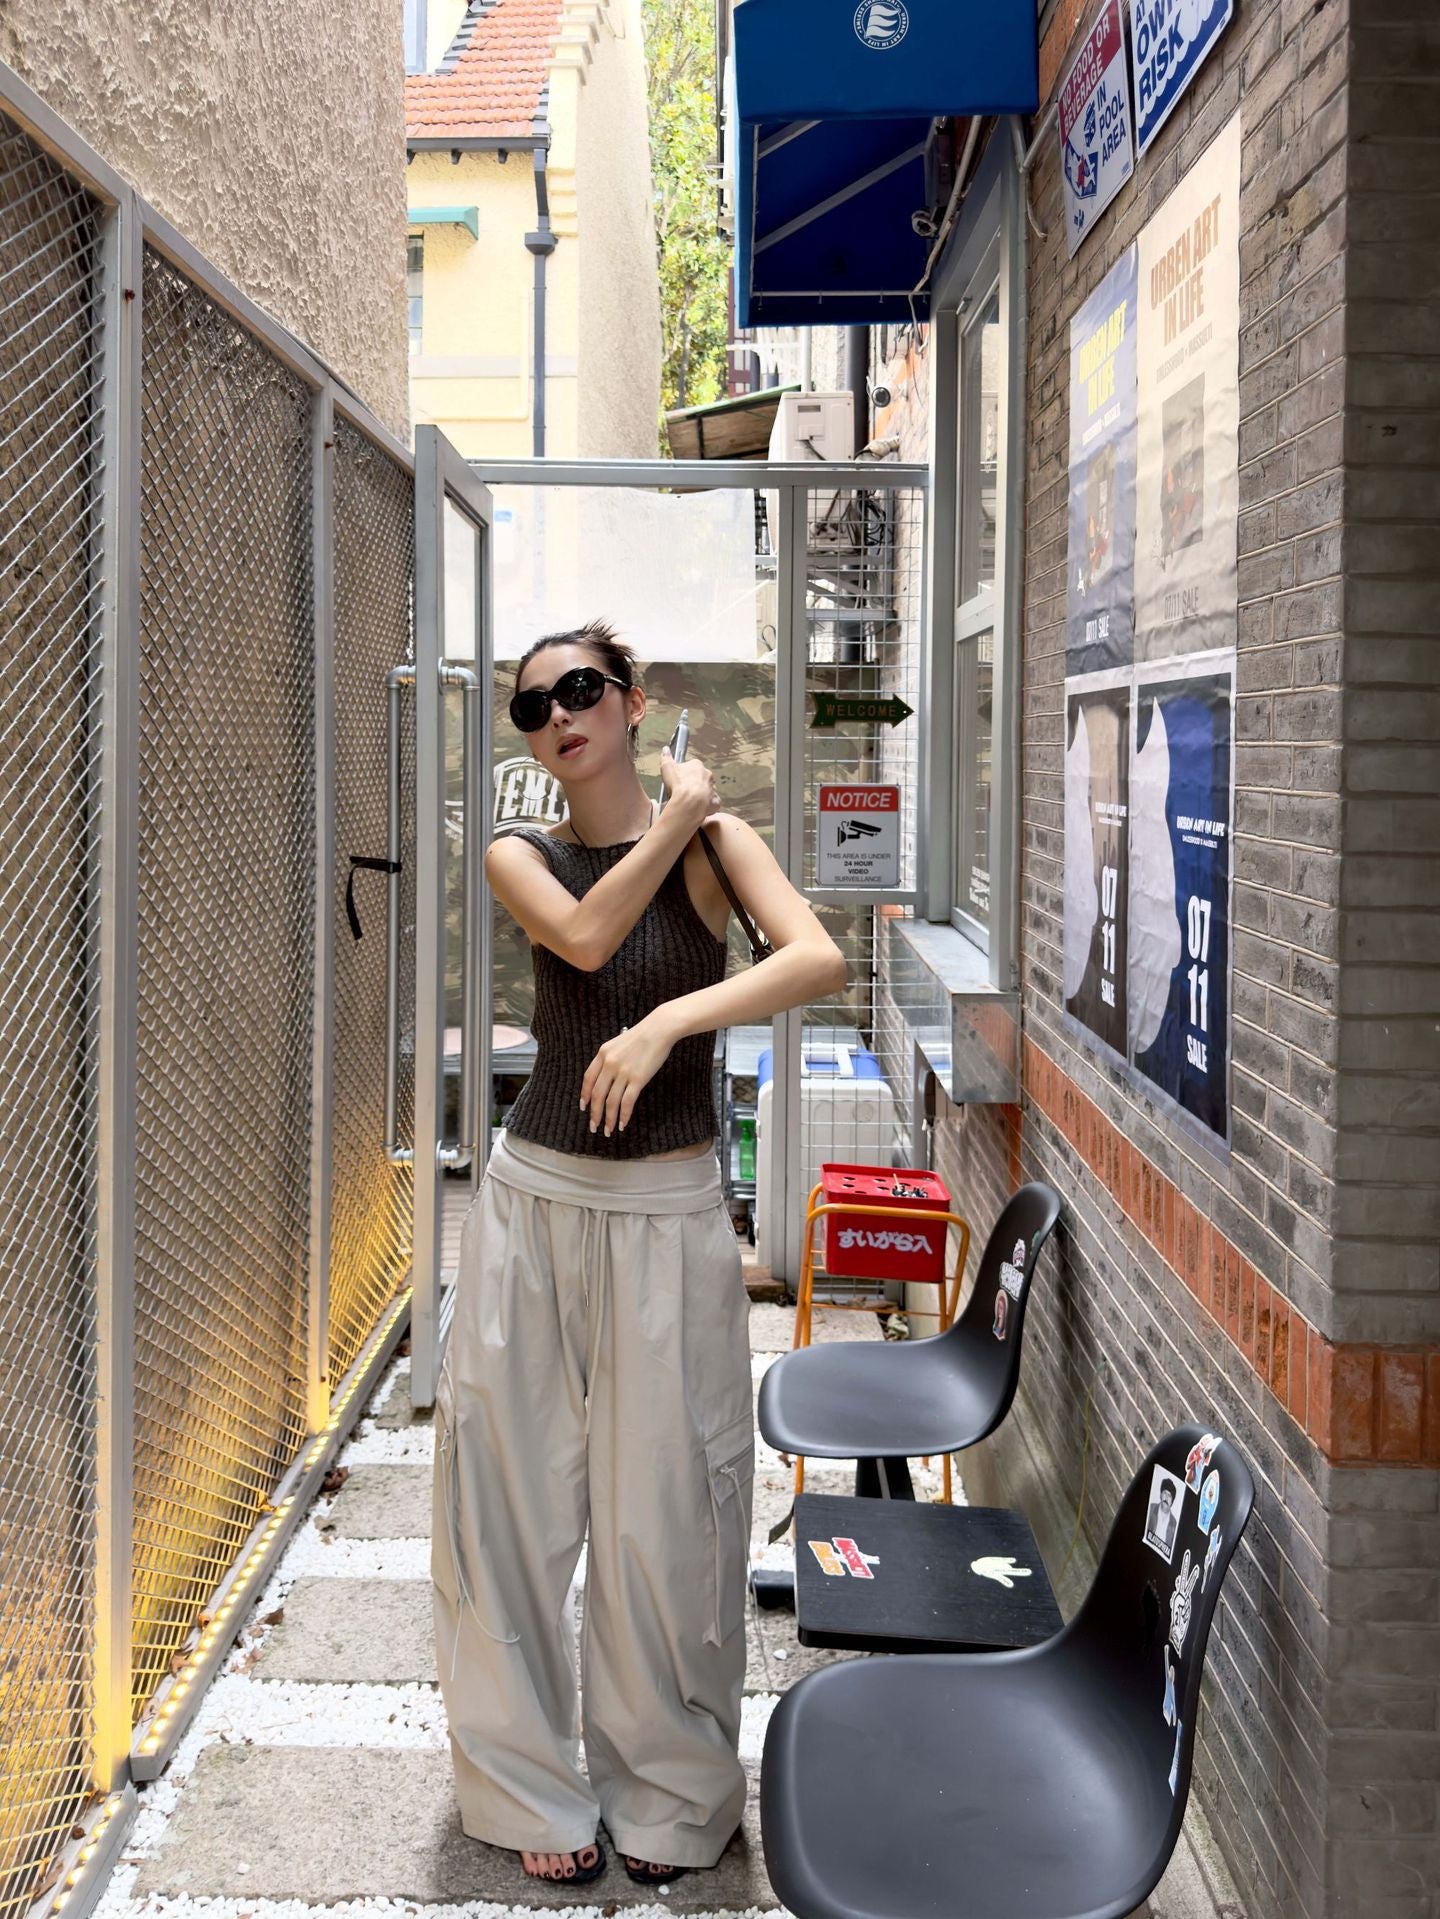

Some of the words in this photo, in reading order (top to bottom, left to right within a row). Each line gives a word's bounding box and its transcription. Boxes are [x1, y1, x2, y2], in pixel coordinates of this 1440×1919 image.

[1062, 84, 1072, 113] NO
[1073, 41, 1094, 93] FOOD
[1096, 13, 1110, 49] OR
[1139, 8, 1184, 112] RISK
[1064, 52, 1103, 134] BEVERAGE
[1097, 80, 1107, 112] IN
[1099, 89, 1125, 139] POOL
[1102, 117, 1126, 167] AREA
[1151, 227, 1191, 311] URBEN
[1193, 192, 1221, 269] ART
[1164, 292, 1177, 347] IN
[1179, 265, 1205, 334] LIFE
[1182, 586, 1199, 617] SALE
[1098, 615, 1109, 639] SALE
[826, 703, 896, 717] WELCOME
[826, 792, 892, 808] NOTICE
[826, 852, 841, 860] THIS
[843, 852, 860, 860] AREA
[868, 852, 891, 860] UNDER
[1101, 864, 1118, 919] 07
[1102, 920, 1115, 975] 11
[1187, 895, 1212, 963] 07
[1101, 977, 1116, 1008] SALE
[1187, 963, 1208, 1032] 11
[1187, 1034, 1208, 1074] SALE
[837, 1227, 933, 1255] すいがら入
